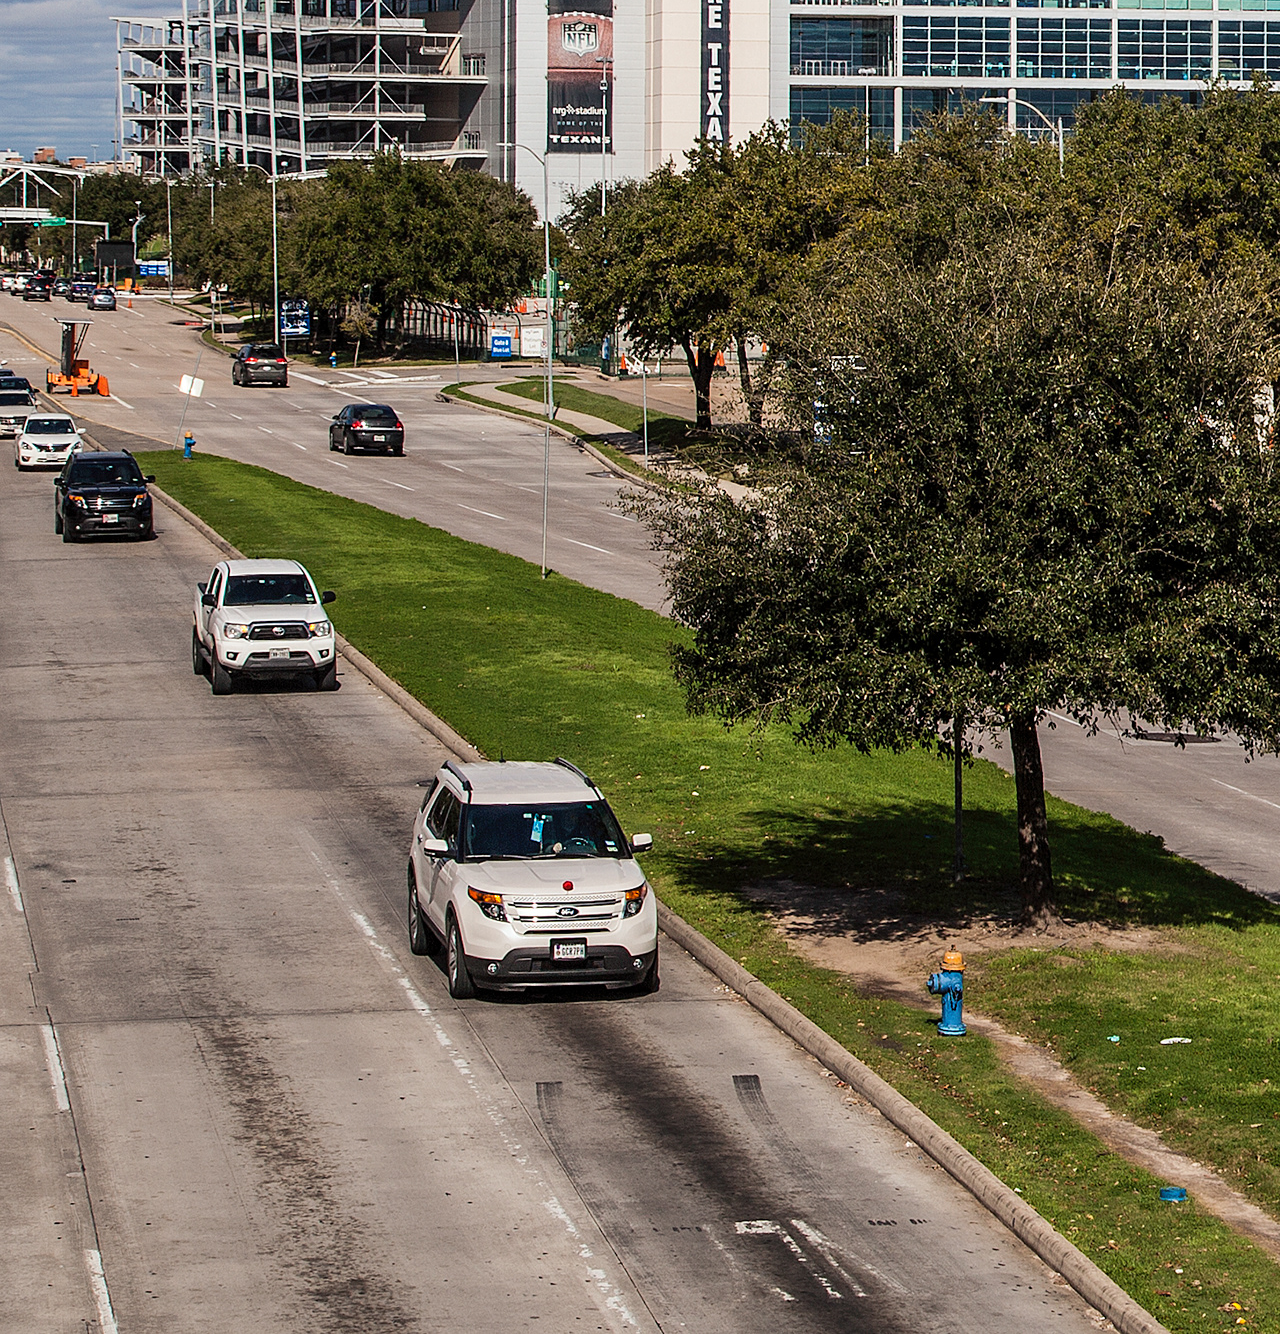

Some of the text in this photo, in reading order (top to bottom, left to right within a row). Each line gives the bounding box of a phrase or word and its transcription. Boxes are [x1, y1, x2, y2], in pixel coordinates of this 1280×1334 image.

[566, 32, 595, 49] NFL
[706, 42, 724, 154] TEXA
[552, 107, 567, 117] nrg
[549, 134, 611, 144] TEXANS
